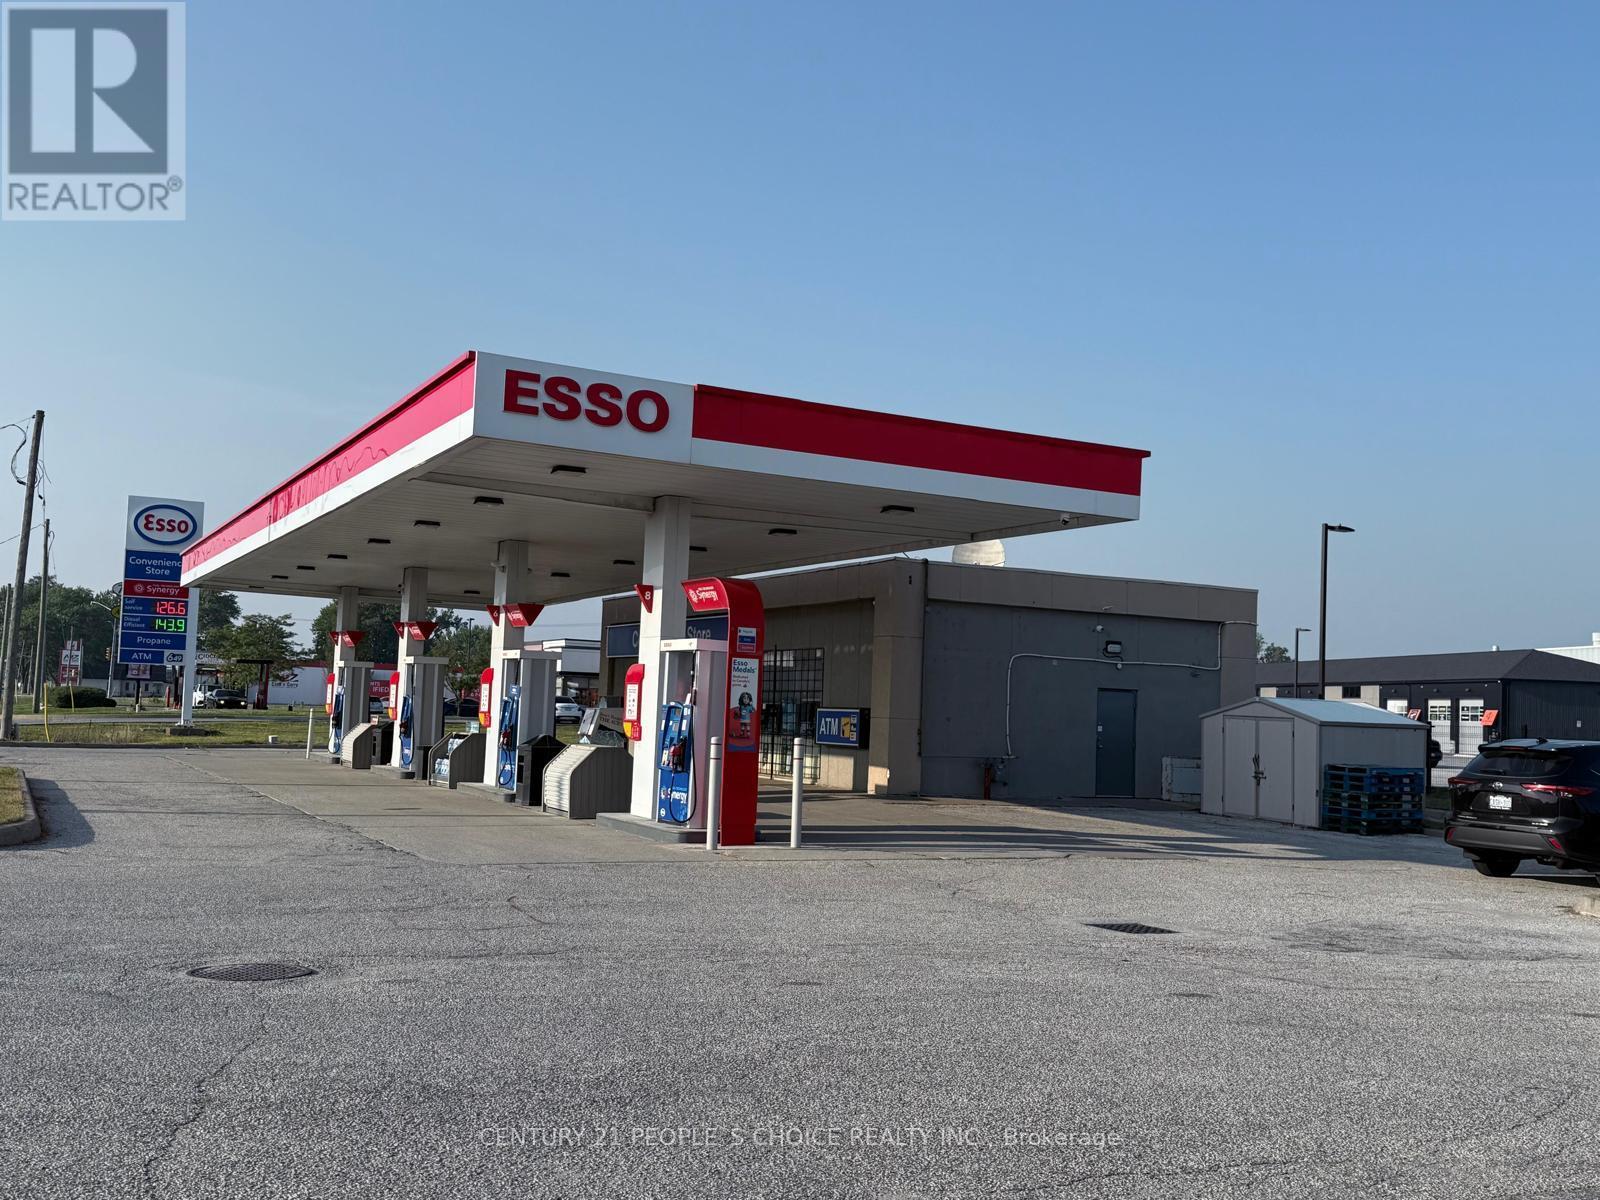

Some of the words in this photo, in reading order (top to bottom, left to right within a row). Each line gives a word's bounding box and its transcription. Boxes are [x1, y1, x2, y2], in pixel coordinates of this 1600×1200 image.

[503, 369, 670, 433] ESSO
[129, 556, 182, 568] Convenienc
[145, 566, 170, 576] Store
[146, 585, 180, 596] Synergy
[644, 590, 651, 600] 8
[696, 590, 719, 602] Synergy
[156, 601, 186, 615] 126.6
[155, 618, 185, 632] 143.9
[687, 626, 712, 639] Store
[137, 636, 171, 646] Propane
[131, 652, 152, 661] ATM
[733, 659, 748, 667] Esso
[820, 718, 839, 735] ATM
